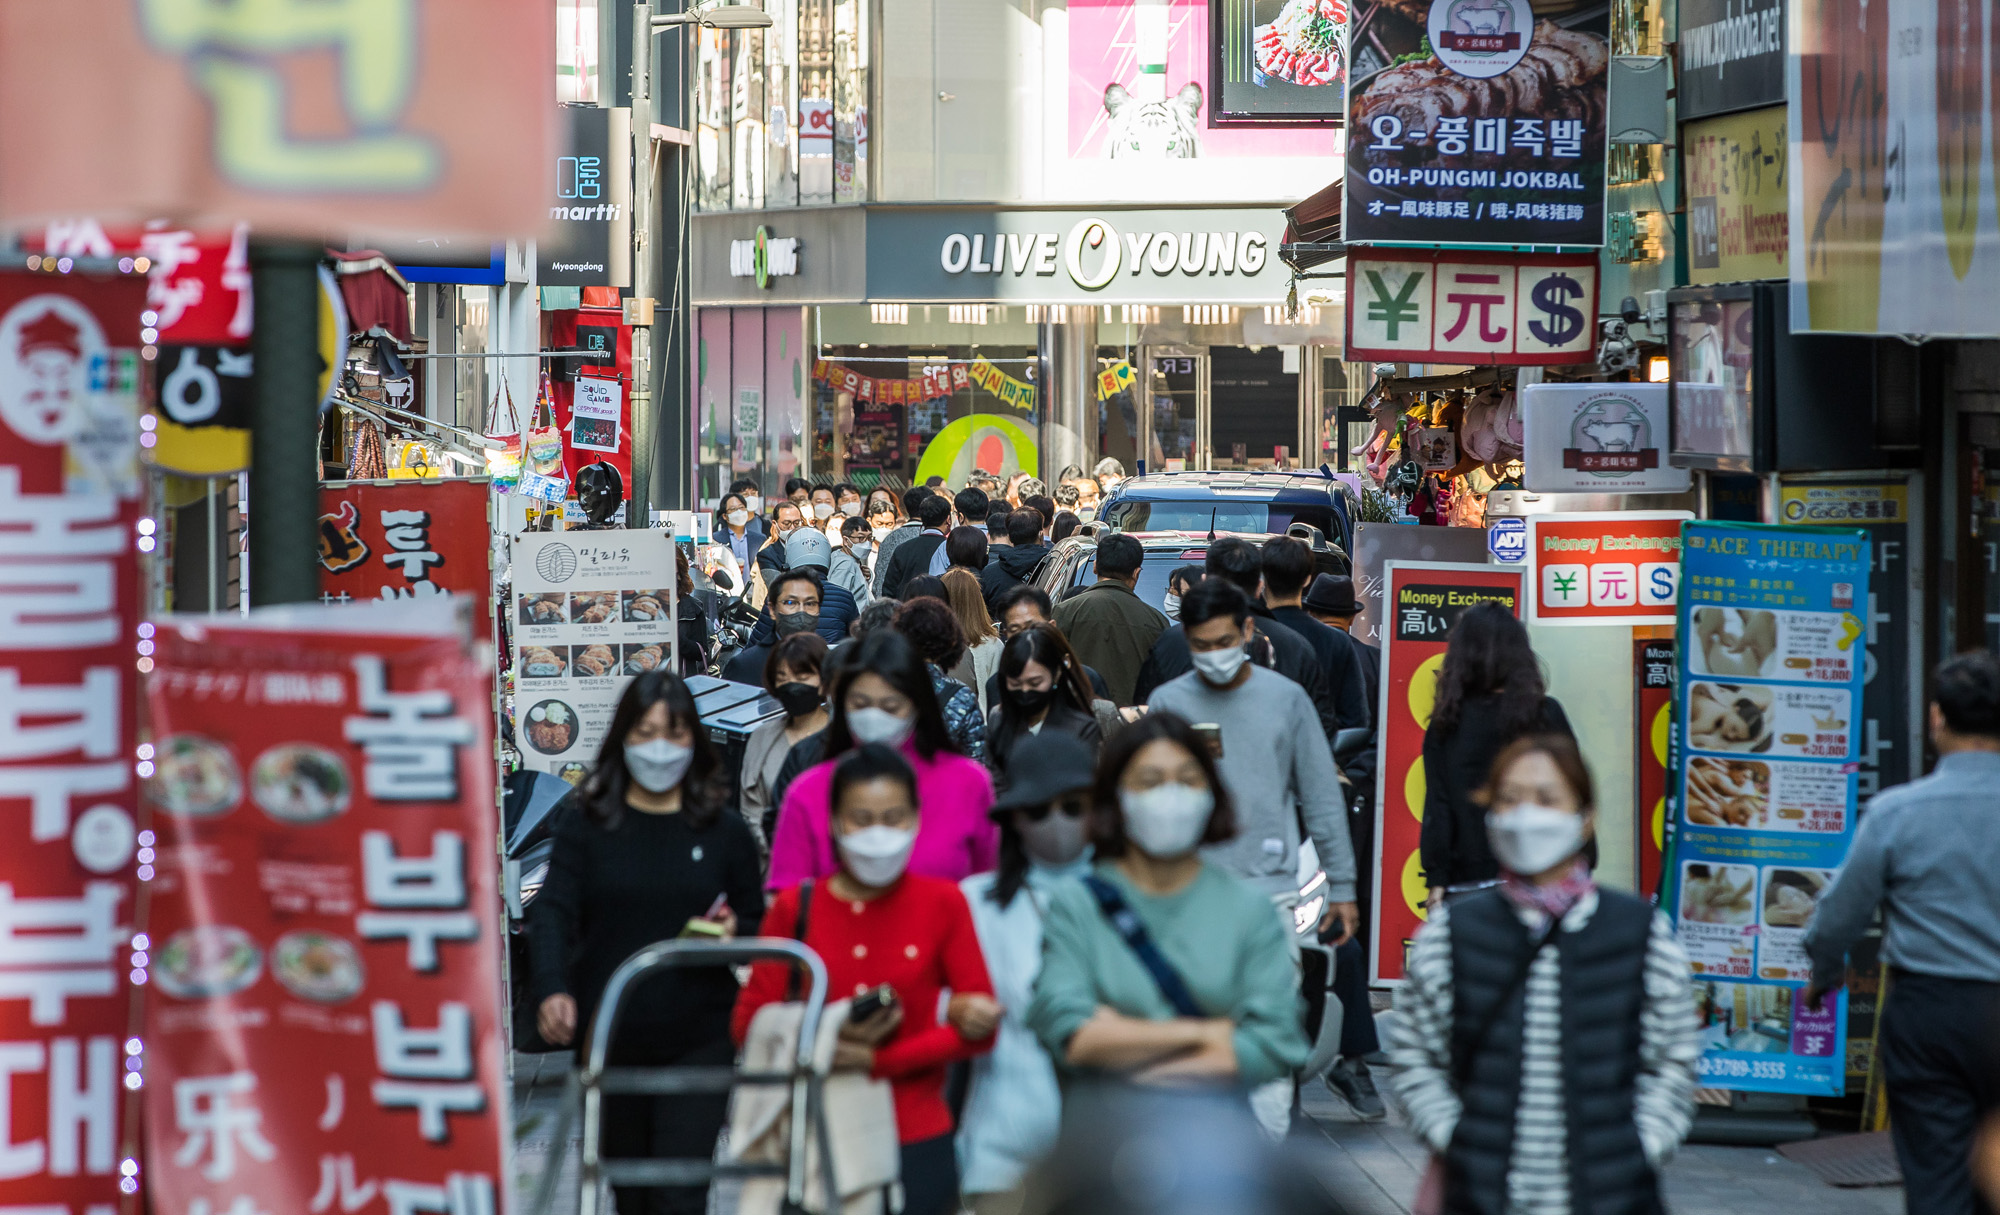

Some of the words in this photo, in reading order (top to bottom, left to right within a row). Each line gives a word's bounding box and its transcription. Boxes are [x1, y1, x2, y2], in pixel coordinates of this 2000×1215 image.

[1683, 0, 1780, 79] www.xphobia.net
[1368, 168, 1495, 188] OH-PUNGMI
[1500, 170, 1584, 190] JOKBAL
[941, 233, 1059, 276] OLIVE
[1125, 231, 1266, 276] YOUNG
[552, 262, 604, 272] Myeongdong
[1365, 270, 1425, 341] ¥
[1443, 273, 1508, 343] 元
[1528, 271, 1584, 348] $
[581, 383, 608, 396] SQUID
[1494, 531, 1527, 549] ADT
[1544, 535, 1599, 553] Money
[1602, 533, 1683, 554] Exchange
[1707, 537, 1749, 555] ACE
[1758, 539, 1862, 561] THERAPY
[1356, 574, 1385, 599] Vie
[1553, 571, 1577, 600] ¥
[1598, 571, 1628, 600] 元
[1650, 567, 1675, 601] $
[1400, 590, 1445, 607] Money
[1448, 592, 1514, 608] Exchange
[1401, 607, 1447, 634] 高い
[1646, 648, 1675, 659] Mon
[0, 465, 130, 1215] 놀부부대
[1804, 1035, 1826, 1054] 3F
